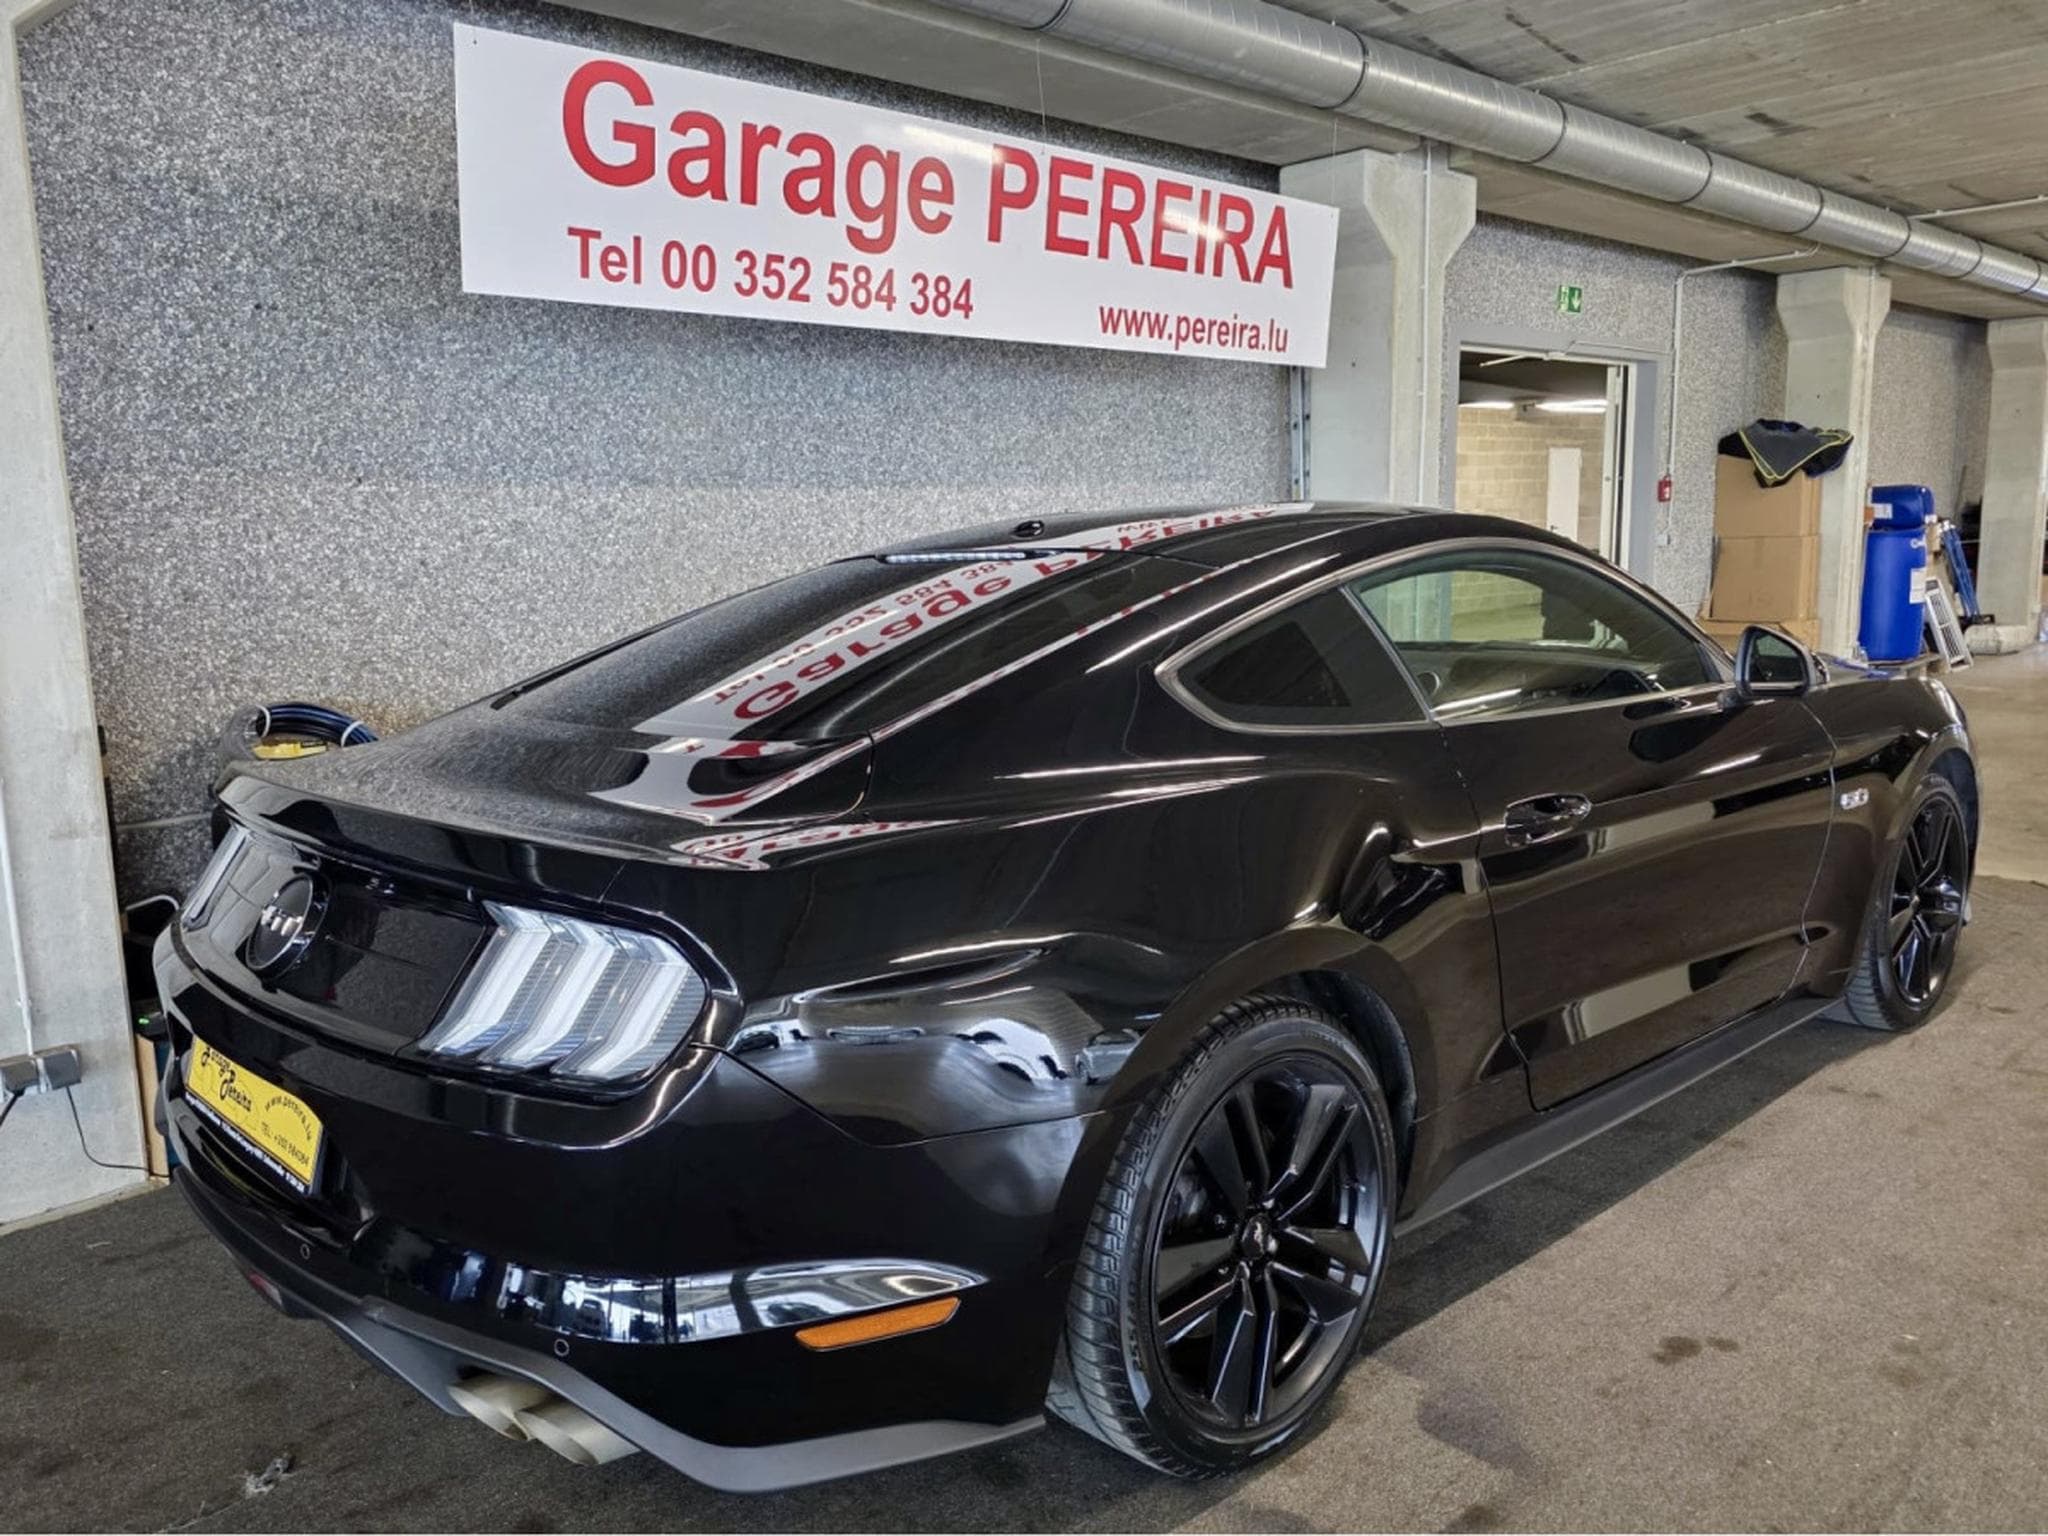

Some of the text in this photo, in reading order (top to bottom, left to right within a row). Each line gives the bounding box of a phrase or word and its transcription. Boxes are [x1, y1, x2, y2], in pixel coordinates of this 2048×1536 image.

[562, 59, 1294, 289] Garage PEREIRA
[567, 226, 974, 320] Tel 00 352 584 384
[1099, 305, 1289, 354] www.pereira.lu
